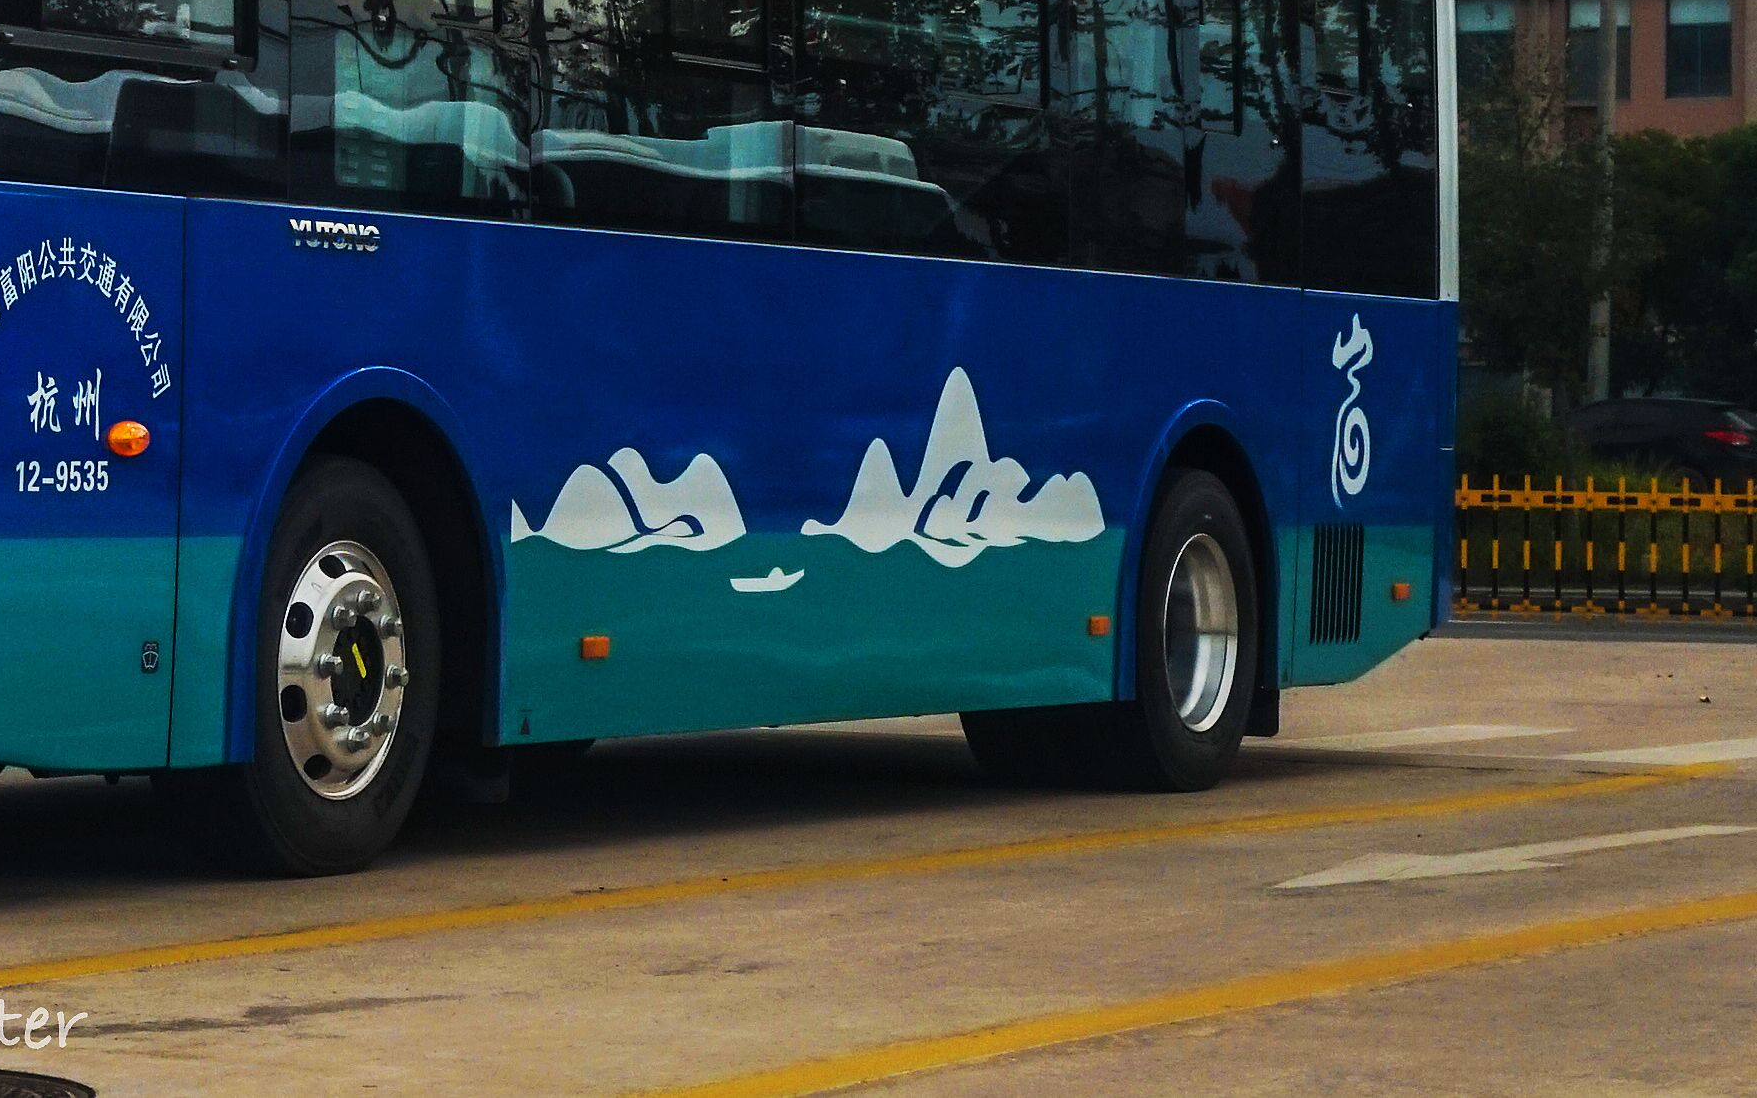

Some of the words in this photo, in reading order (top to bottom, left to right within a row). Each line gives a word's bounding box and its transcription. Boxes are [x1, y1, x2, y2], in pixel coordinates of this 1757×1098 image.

[289, 218, 381, 252] YUTONG
[27, 368, 102, 442] 杭州
[15, 460, 109, 492] 12-9535
